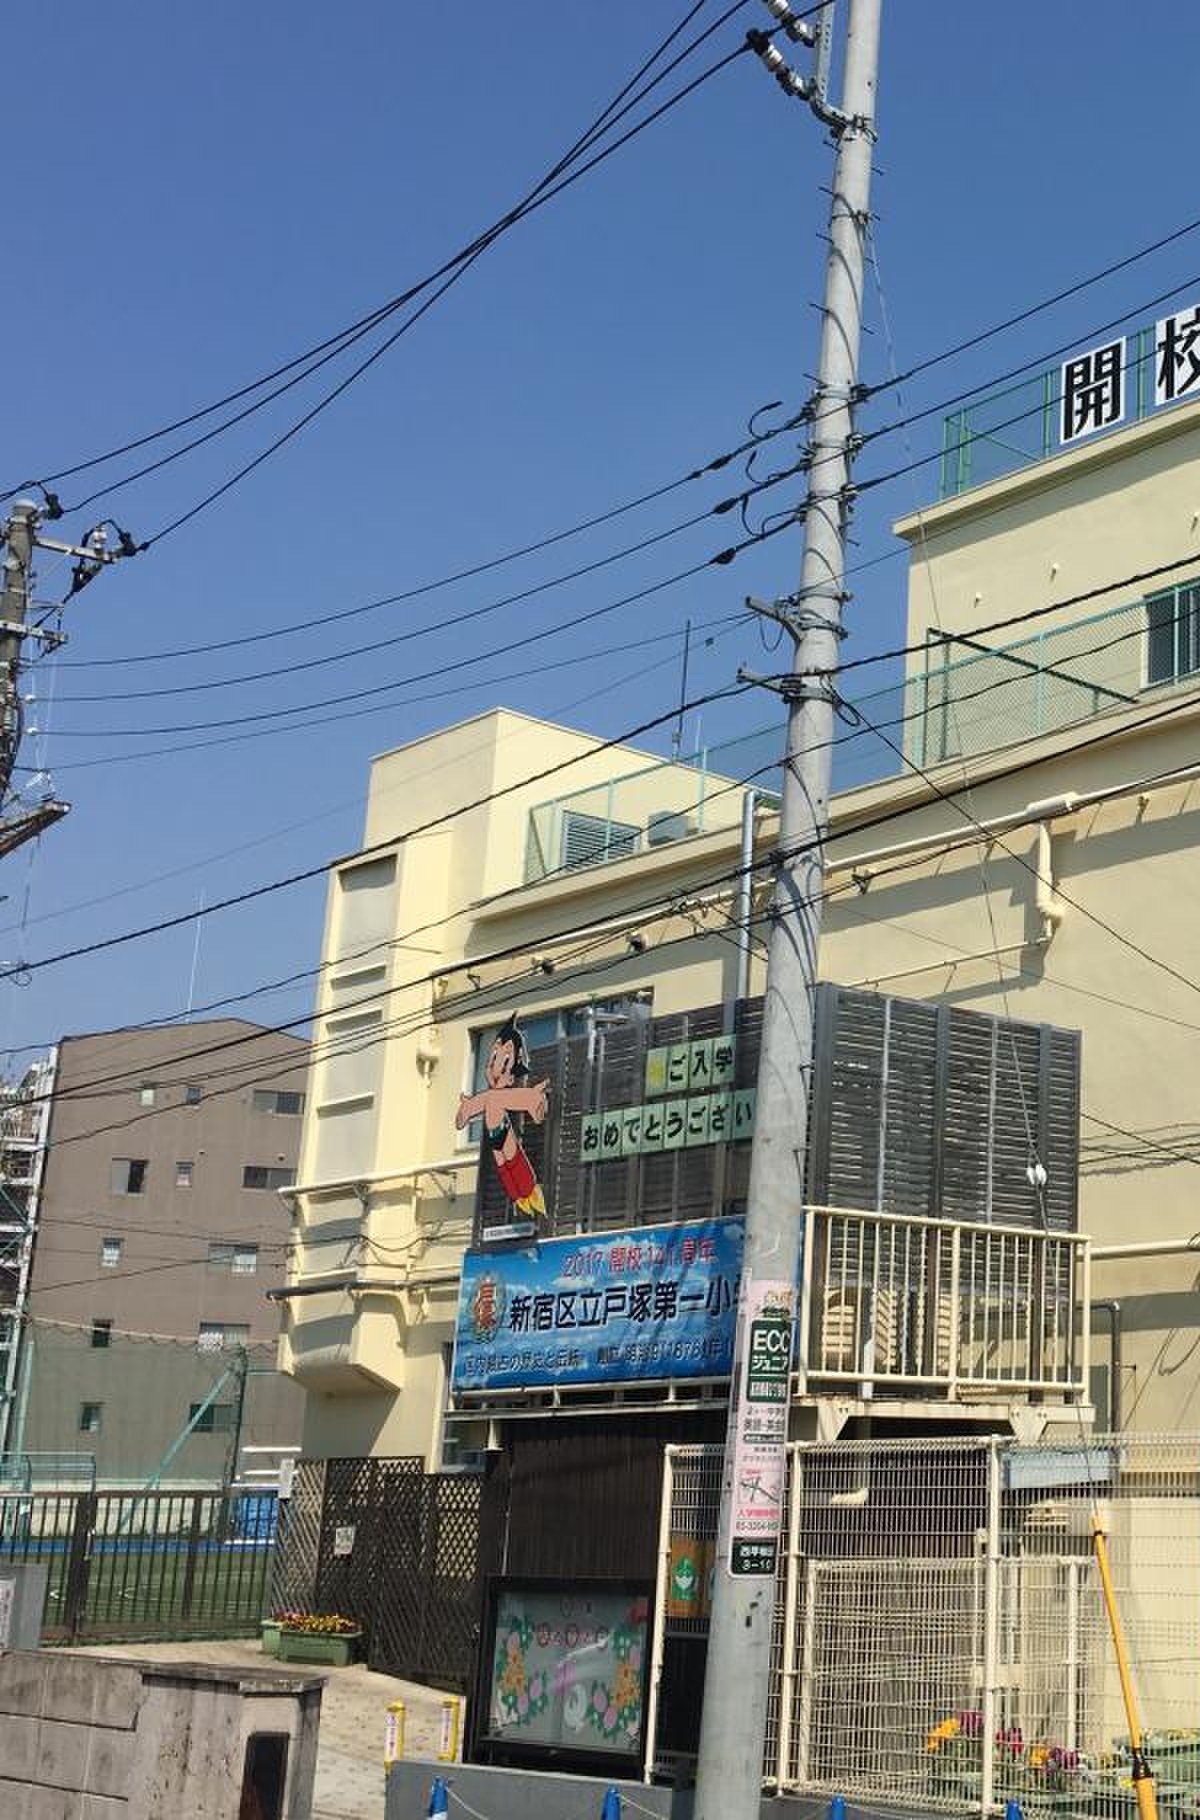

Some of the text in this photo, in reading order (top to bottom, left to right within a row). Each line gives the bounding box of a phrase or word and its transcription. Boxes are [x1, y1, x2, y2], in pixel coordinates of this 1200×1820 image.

[669, 1046, 733, 1082] ご入学
[583, 1103, 753, 1152] おめでとうござい
[562, 1249, 603, 1278] 2017
[753, 1329, 791, 1353] ECC
